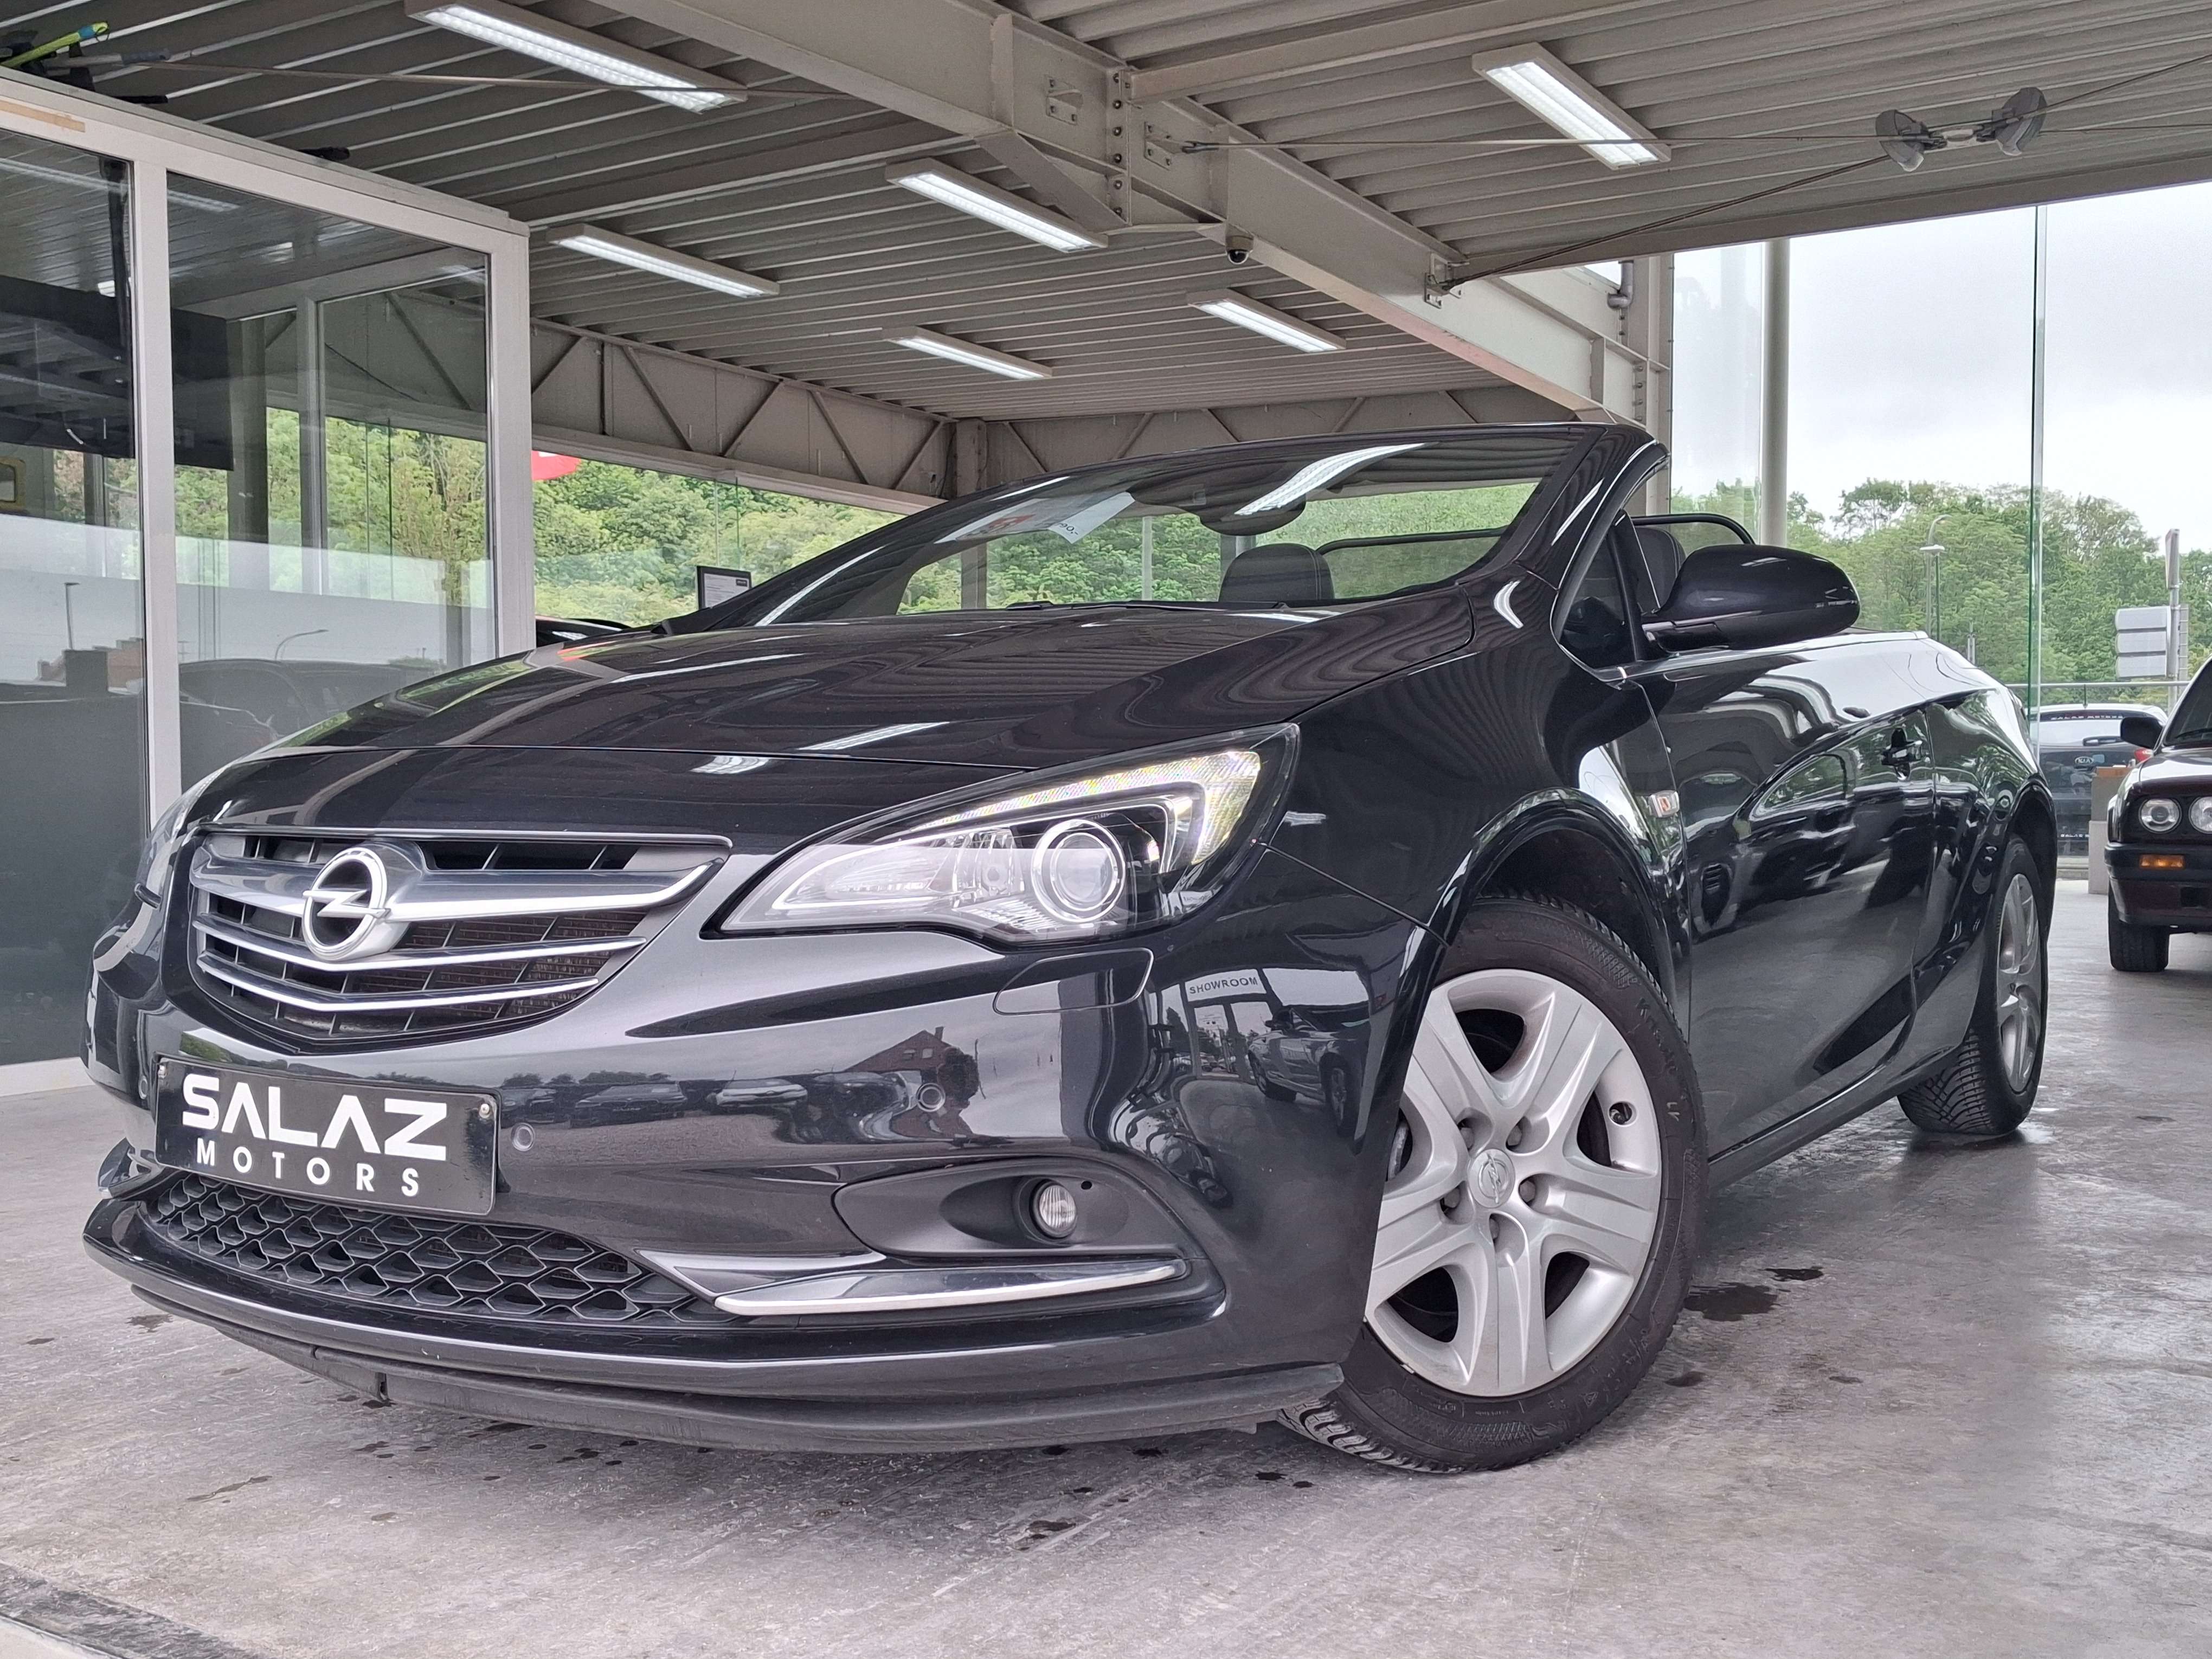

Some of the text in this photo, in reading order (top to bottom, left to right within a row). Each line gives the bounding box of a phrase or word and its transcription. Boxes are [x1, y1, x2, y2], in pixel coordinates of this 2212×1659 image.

[1189, 977, 1258, 994] SHOWROOM
[182, 1073, 447, 1161] SALAZ
[197, 1137, 419, 1197] MOTORS
